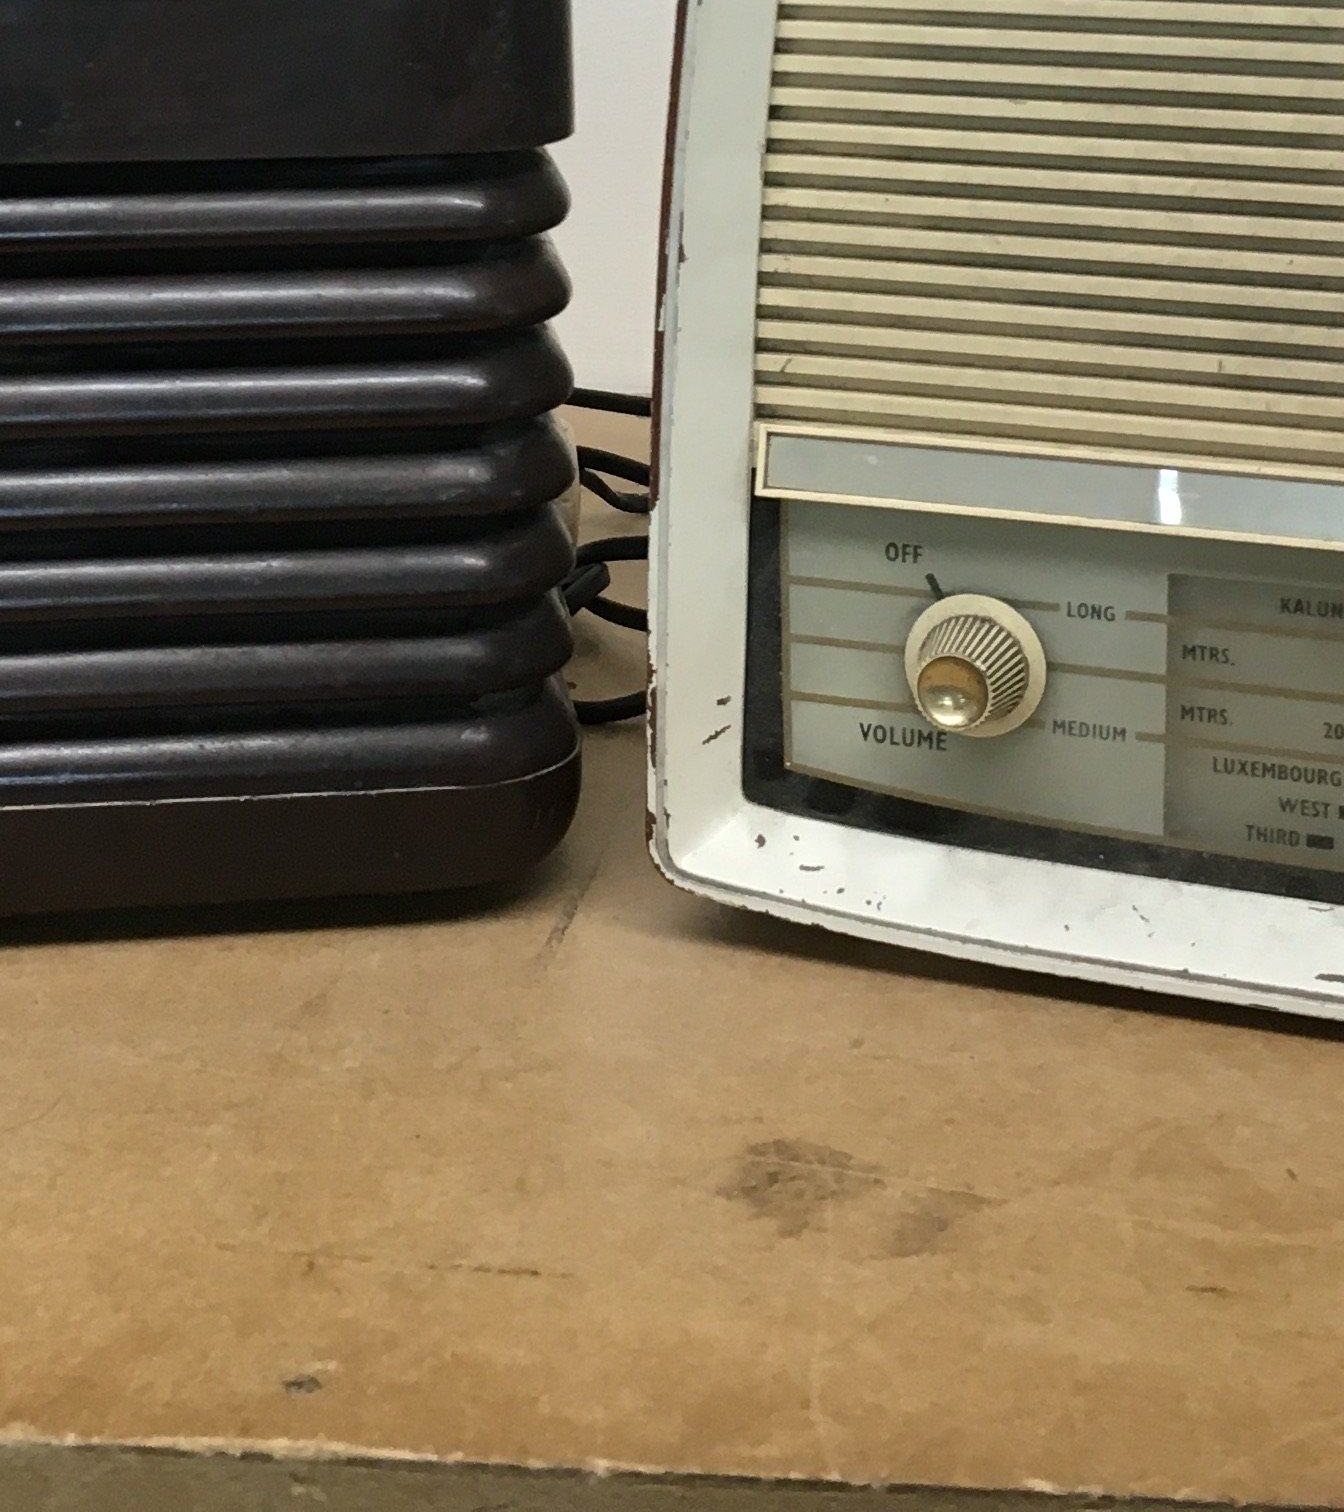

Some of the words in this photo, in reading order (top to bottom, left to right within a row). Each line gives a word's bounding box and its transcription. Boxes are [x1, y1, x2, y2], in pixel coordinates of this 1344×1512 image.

[884, 542, 924, 564] OFF
[1066, 601, 1116, 622] LONG
[1181, 644, 1236, 666] MTRS.
[859, 722, 948, 752] VOLUME
[1052, 719, 1128, 743] MEDIUM
[1212, 756, 1343, 787] LUXEMBOURG
[1278, 796, 1332, 819] WEST
[1245, 824, 1301, 847] THIRD
